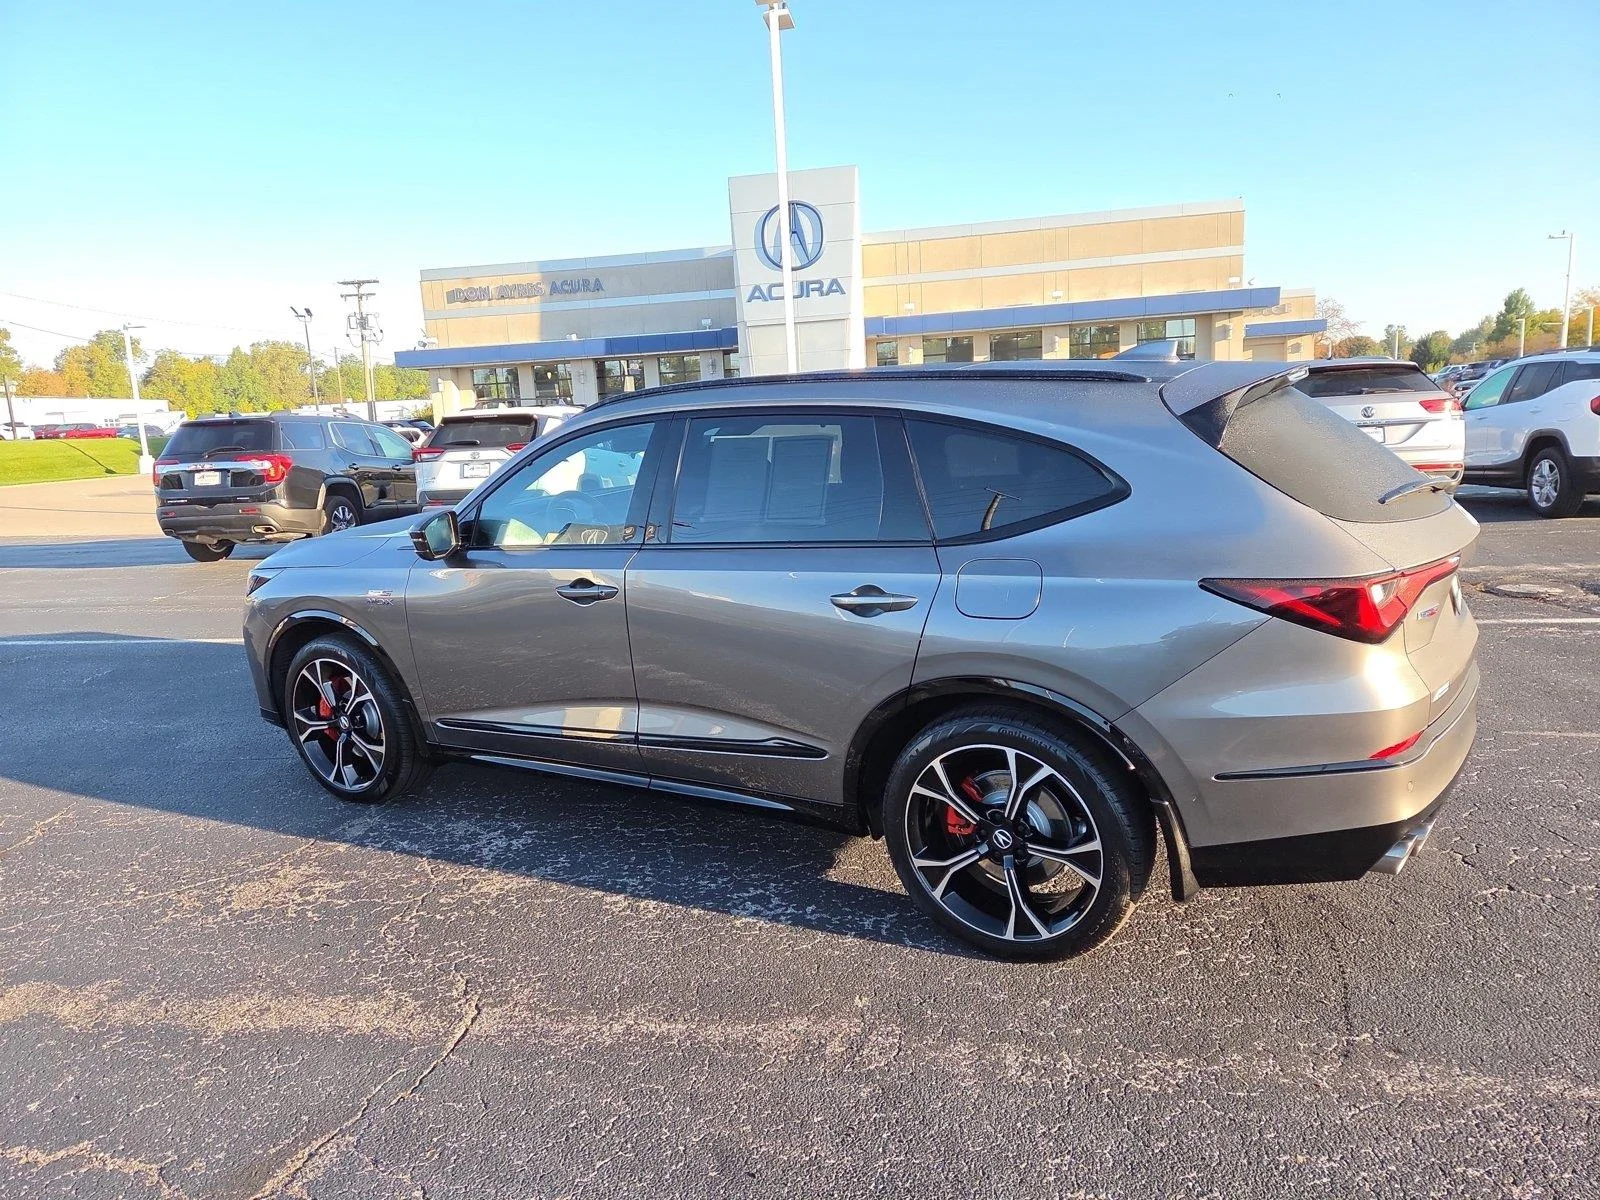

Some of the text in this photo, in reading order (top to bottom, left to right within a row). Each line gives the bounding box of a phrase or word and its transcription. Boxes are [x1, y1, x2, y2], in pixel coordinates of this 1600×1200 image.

[453, 277, 604, 301] DON AYRES ACURA
